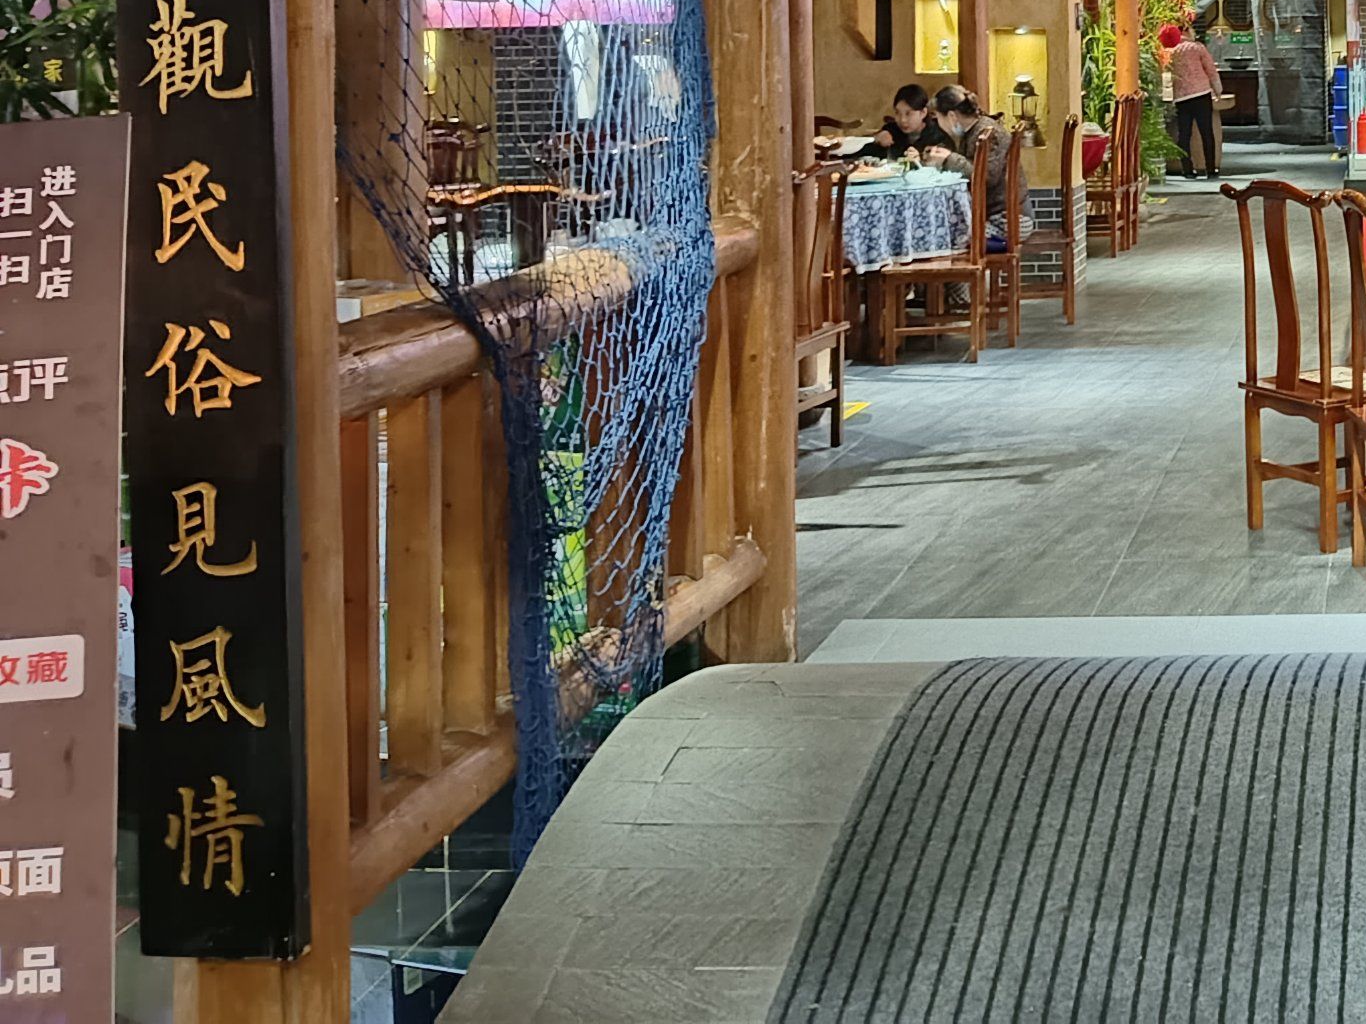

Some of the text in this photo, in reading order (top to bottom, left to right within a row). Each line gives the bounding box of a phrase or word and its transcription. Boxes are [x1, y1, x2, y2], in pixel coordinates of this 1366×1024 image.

[0, 187, 33, 287] 扫一扫
[35, 165, 77, 300] 进入门店
[0, 356, 69, 404] 评
[0, 847, 64, 897] 面
[0, 946, 62, 995] 品
